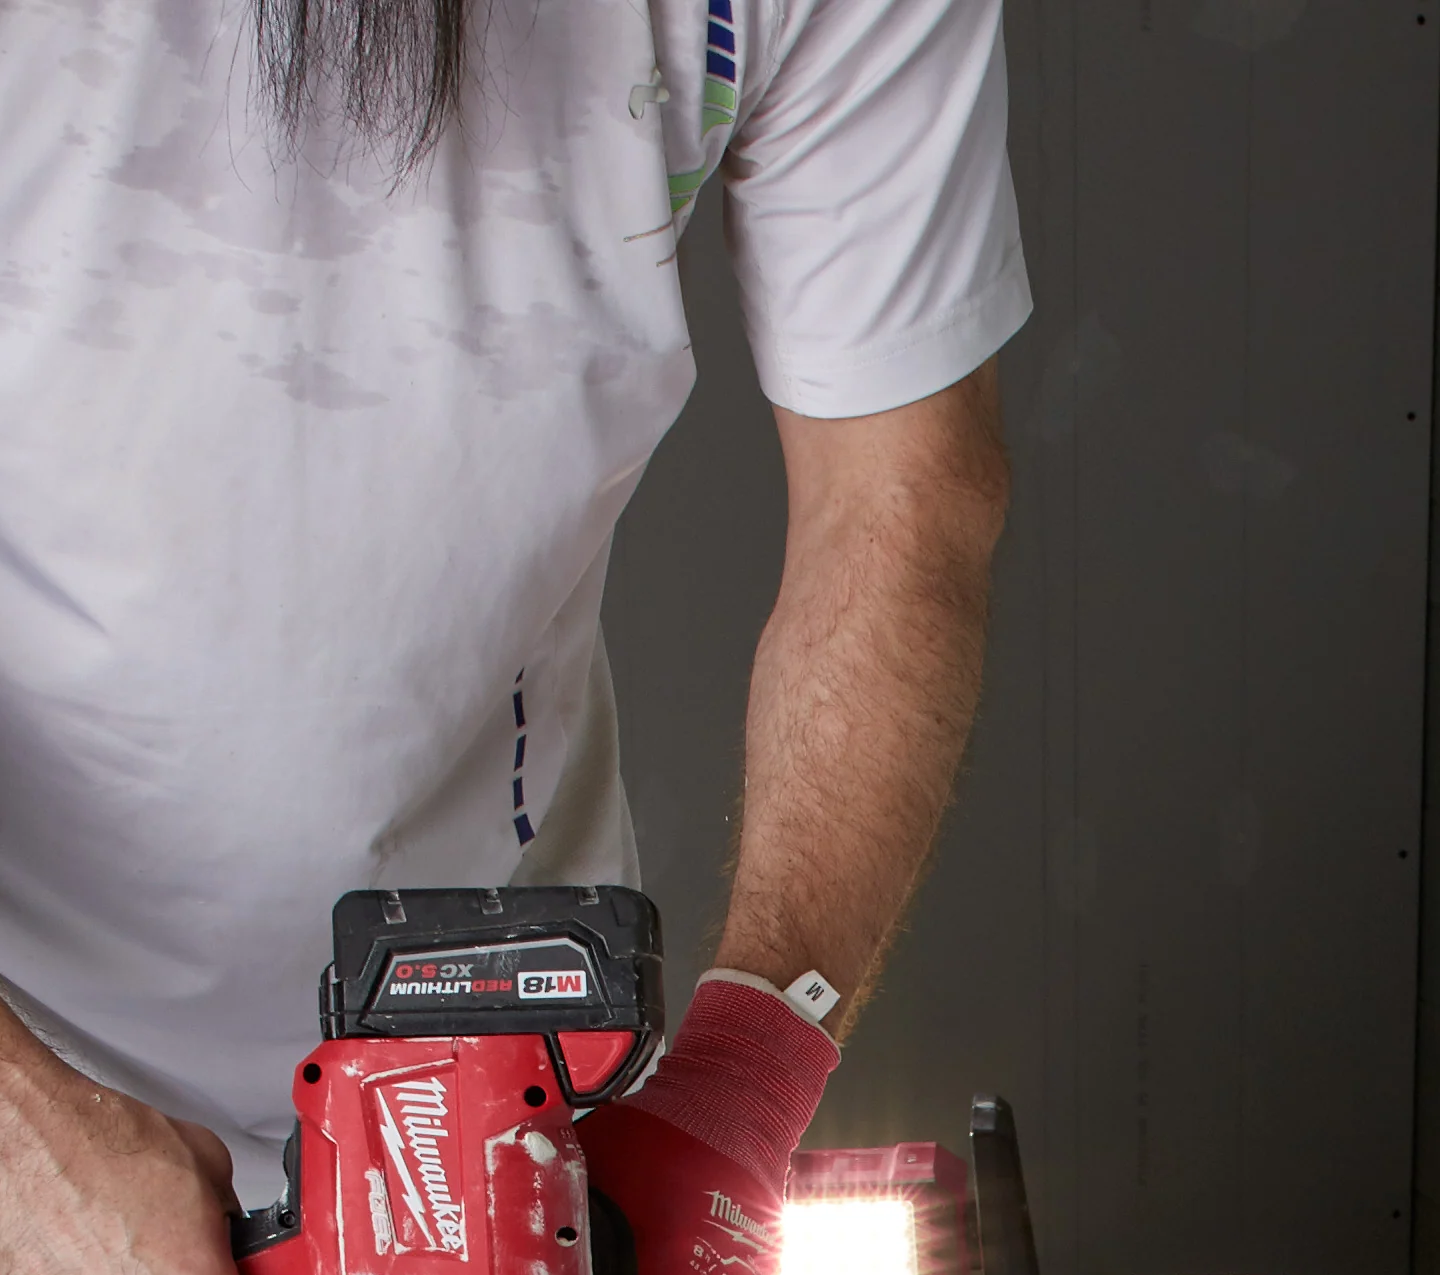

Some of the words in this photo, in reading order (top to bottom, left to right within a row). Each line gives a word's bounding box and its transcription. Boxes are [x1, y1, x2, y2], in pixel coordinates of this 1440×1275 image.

[395, 963, 437, 979] 5.0
[440, 963, 474, 979] XC
[389, 980, 512, 995] REDLITHIUM
[523, 975, 581, 995] M18
[804, 981, 825, 1002] M
[392, 1077, 463, 1250] Milwaukee
[365, 1169, 392, 1255] FUEL
